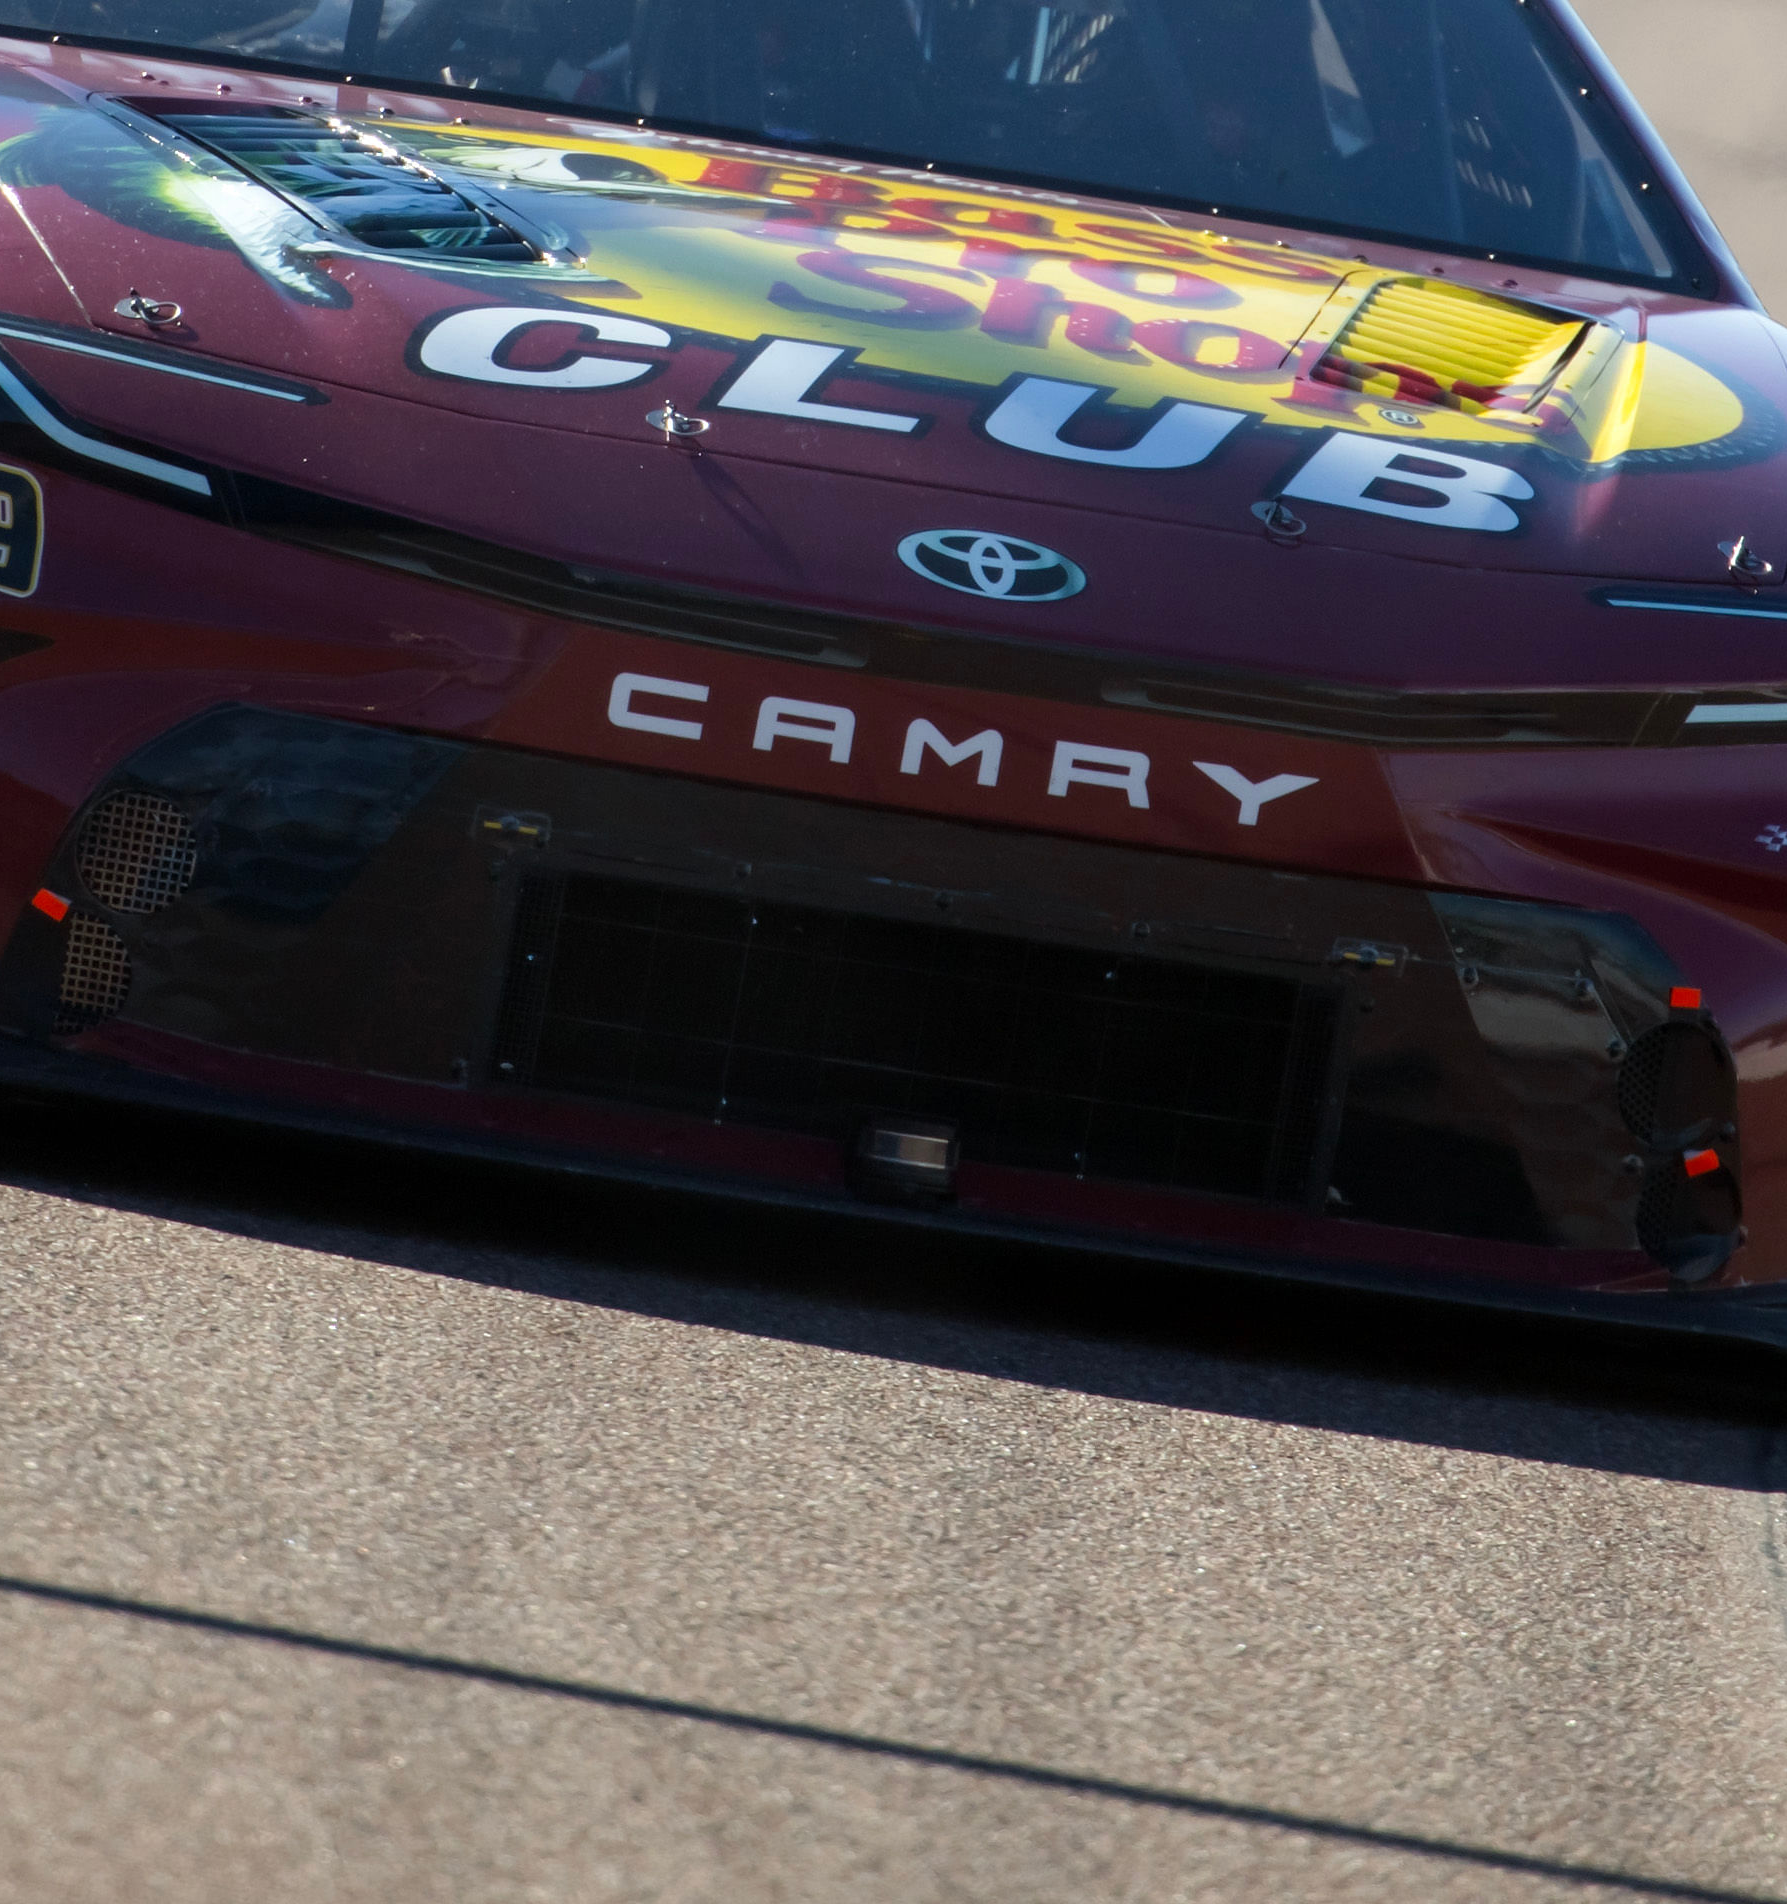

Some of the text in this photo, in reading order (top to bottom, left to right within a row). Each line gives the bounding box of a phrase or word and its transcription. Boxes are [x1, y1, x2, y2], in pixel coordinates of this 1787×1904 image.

[692, 154, 1348, 288] Bass
[757, 201, 1244, 310] Pro
[418, 303, 1536, 533] CLUB
[607, 671, 1321, 827] CAMRY
